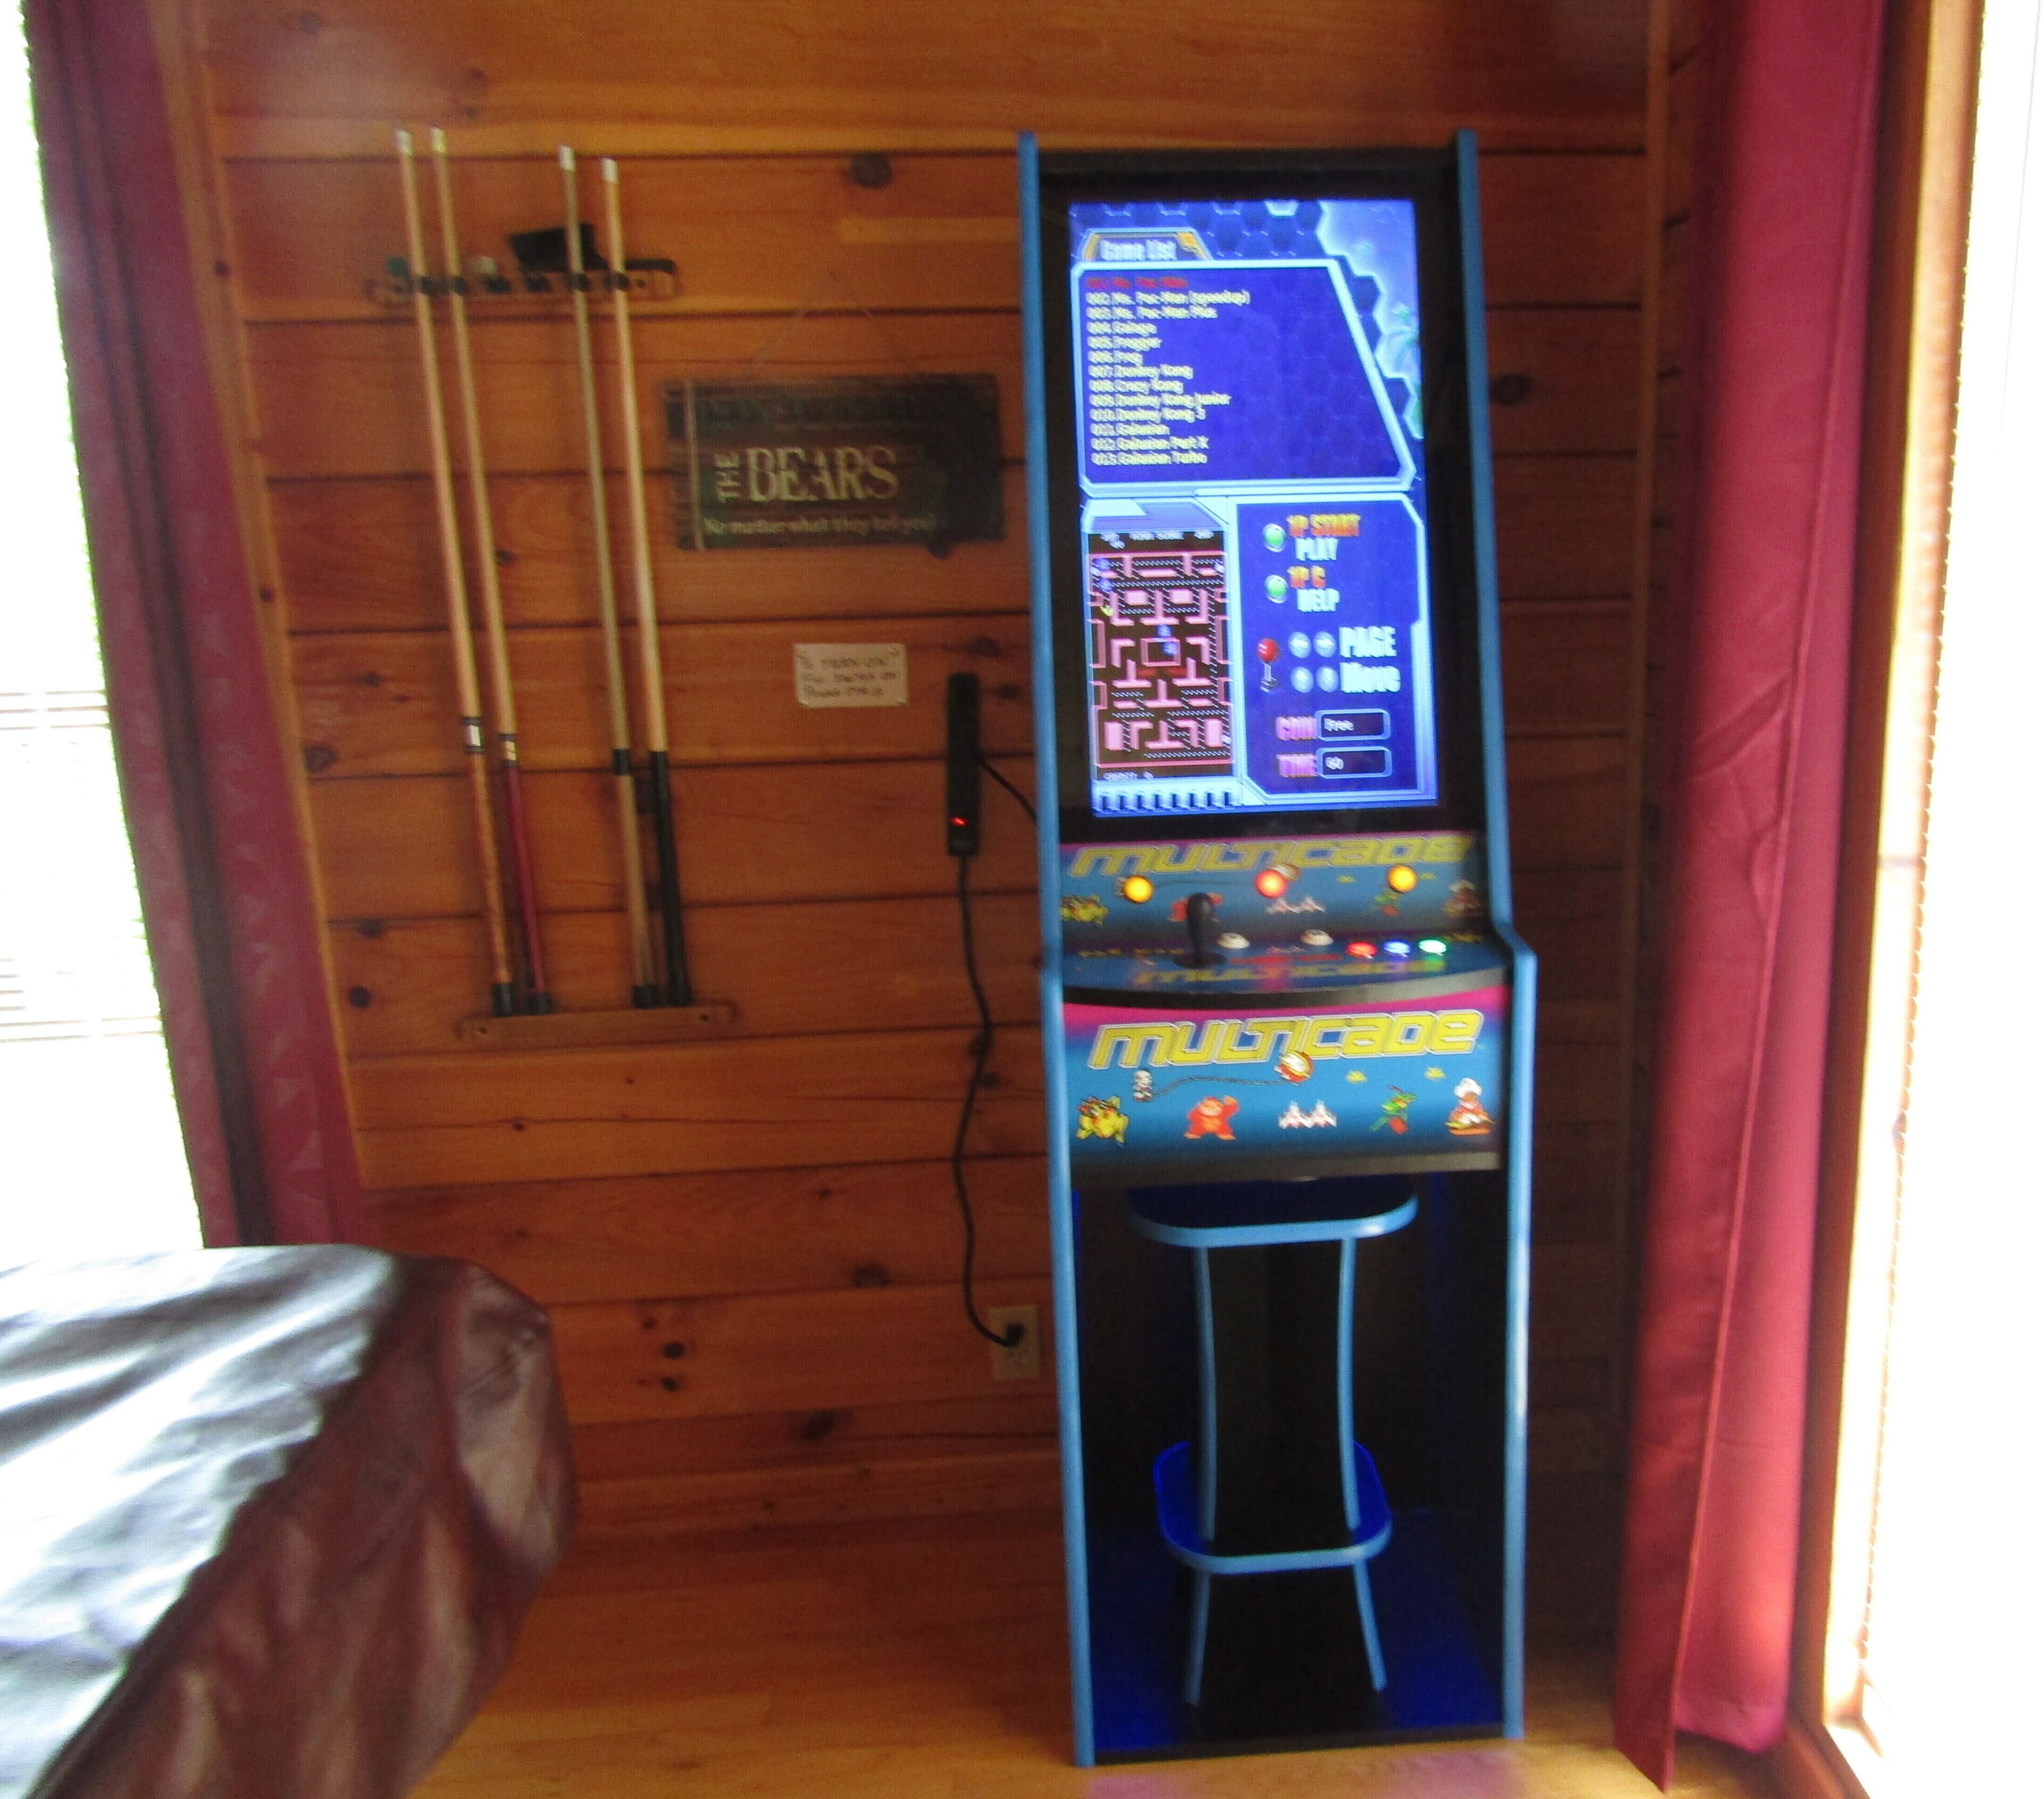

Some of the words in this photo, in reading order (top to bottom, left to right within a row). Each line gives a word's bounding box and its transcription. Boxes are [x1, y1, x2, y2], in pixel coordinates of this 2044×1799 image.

[1160, 364, 1193, 379] Kong
[1150, 379, 1183, 394] Kong
[1161, 393, 1195, 407] Kong
[1162, 408, 1195, 423] Kong
[1196, 407, 1206, 420] 3
[715, 452, 741, 502] THE
[746, 446, 900, 502] BEARS
[1310, 514, 1361, 537] START
[1295, 538, 1339, 561] PLAY
[1297, 588, 1340, 612] HELP
[1339, 625, 1397, 658] PAGE
[1340, 661, 1402, 692] Move
[1276, 716, 1317, 740] COIN
[1324, 717, 1354, 733] Free
[1276, 754, 1317, 778] TIME
[1325, 756, 1344, 770] 60
